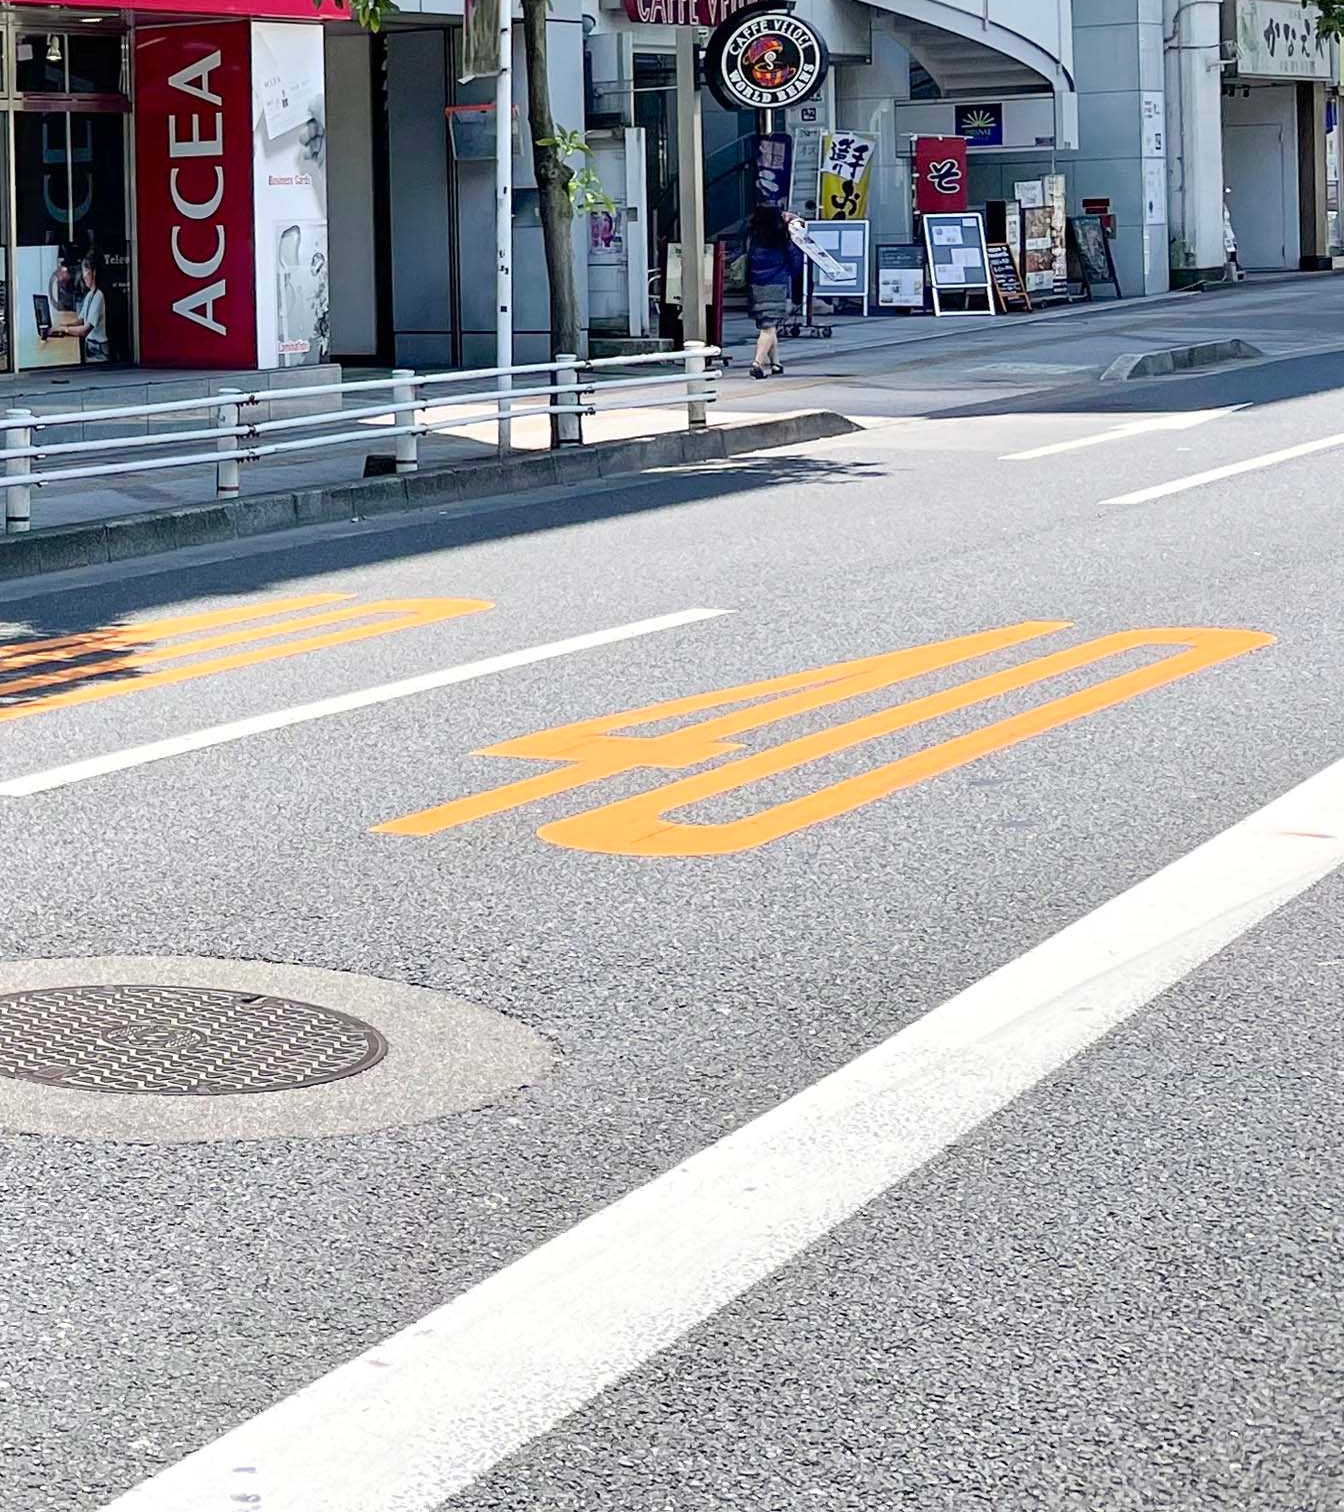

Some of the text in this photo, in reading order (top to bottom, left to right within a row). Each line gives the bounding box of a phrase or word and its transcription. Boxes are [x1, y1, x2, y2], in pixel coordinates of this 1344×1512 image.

[728, 69, 772, 104] WORLD
[730, 18, 769, 55] CAFFE
[168, 50, 227, 336] ACCEA
[367, 619, 1278, 858] 40
